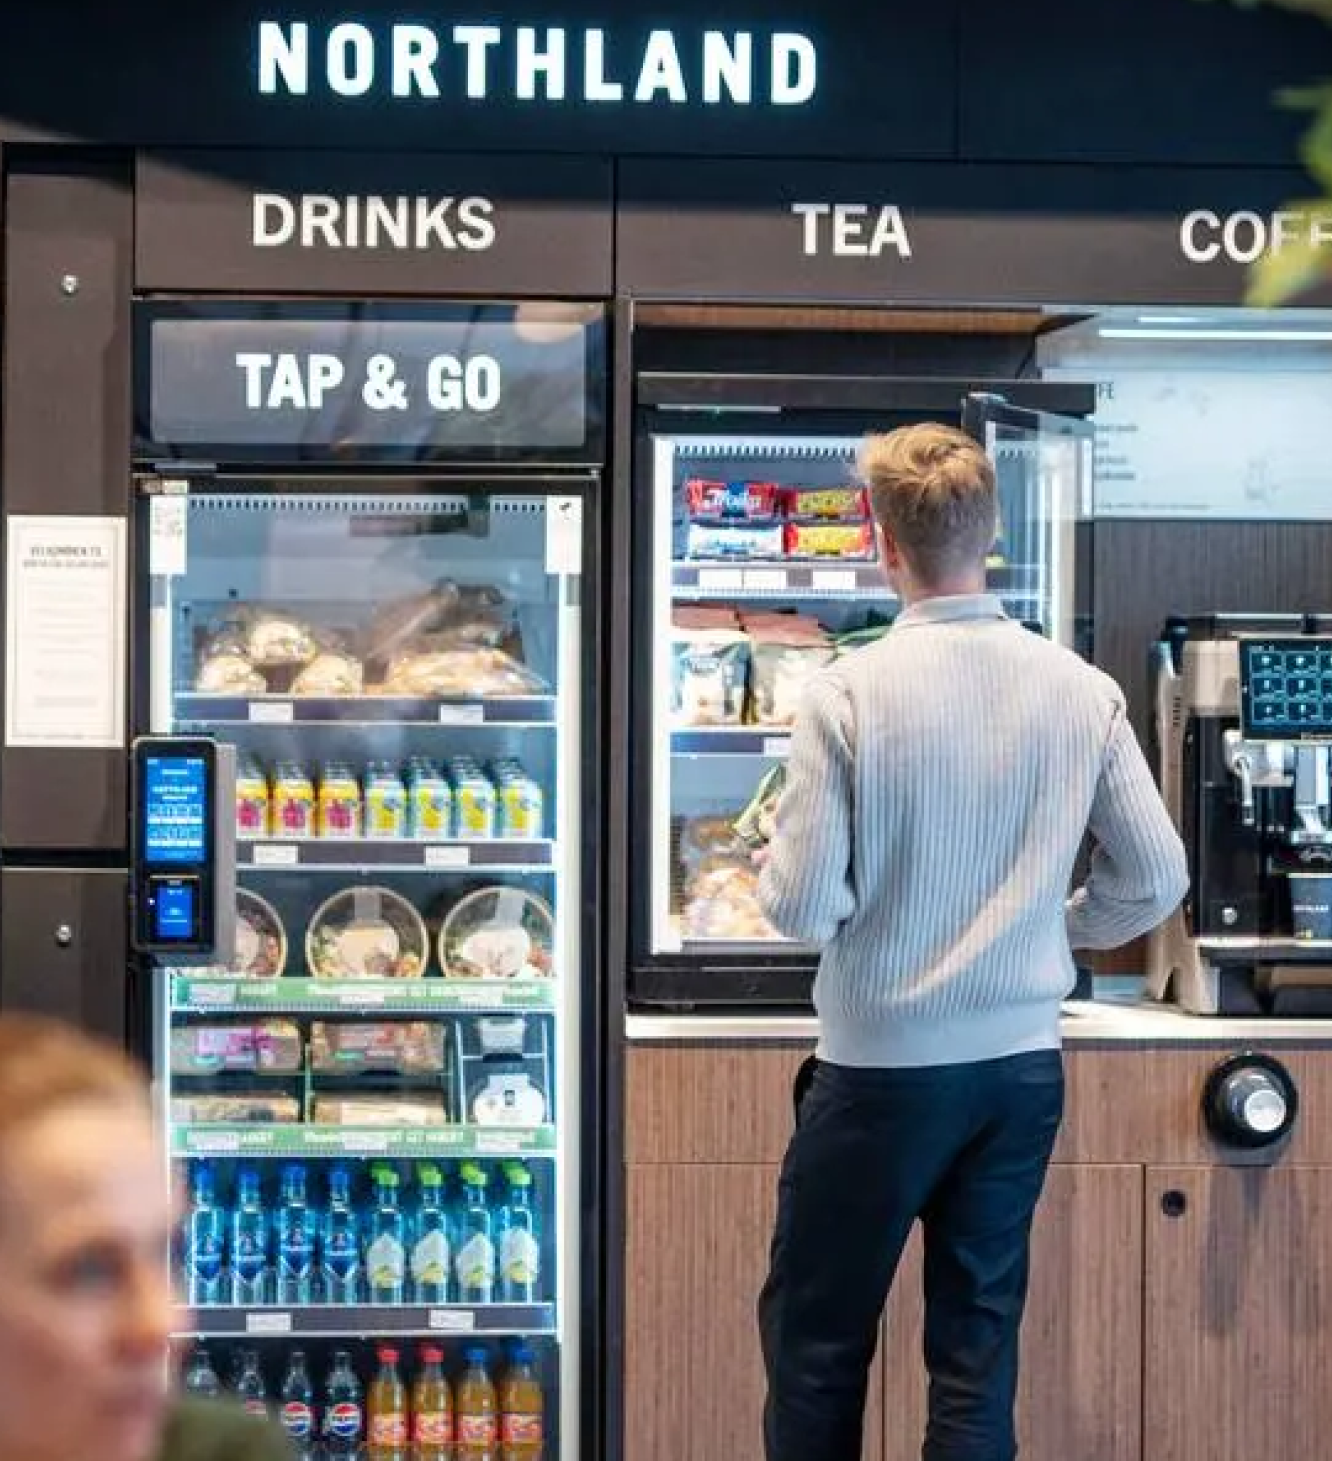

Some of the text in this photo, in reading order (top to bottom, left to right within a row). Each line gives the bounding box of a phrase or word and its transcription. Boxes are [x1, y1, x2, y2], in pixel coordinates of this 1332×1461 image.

[258, 21, 817, 103] NORTHLAND
[253, 194, 496, 250] DRINKS
[792, 203, 913, 259] TEA
[235, 353, 501, 411] TAP & GO
